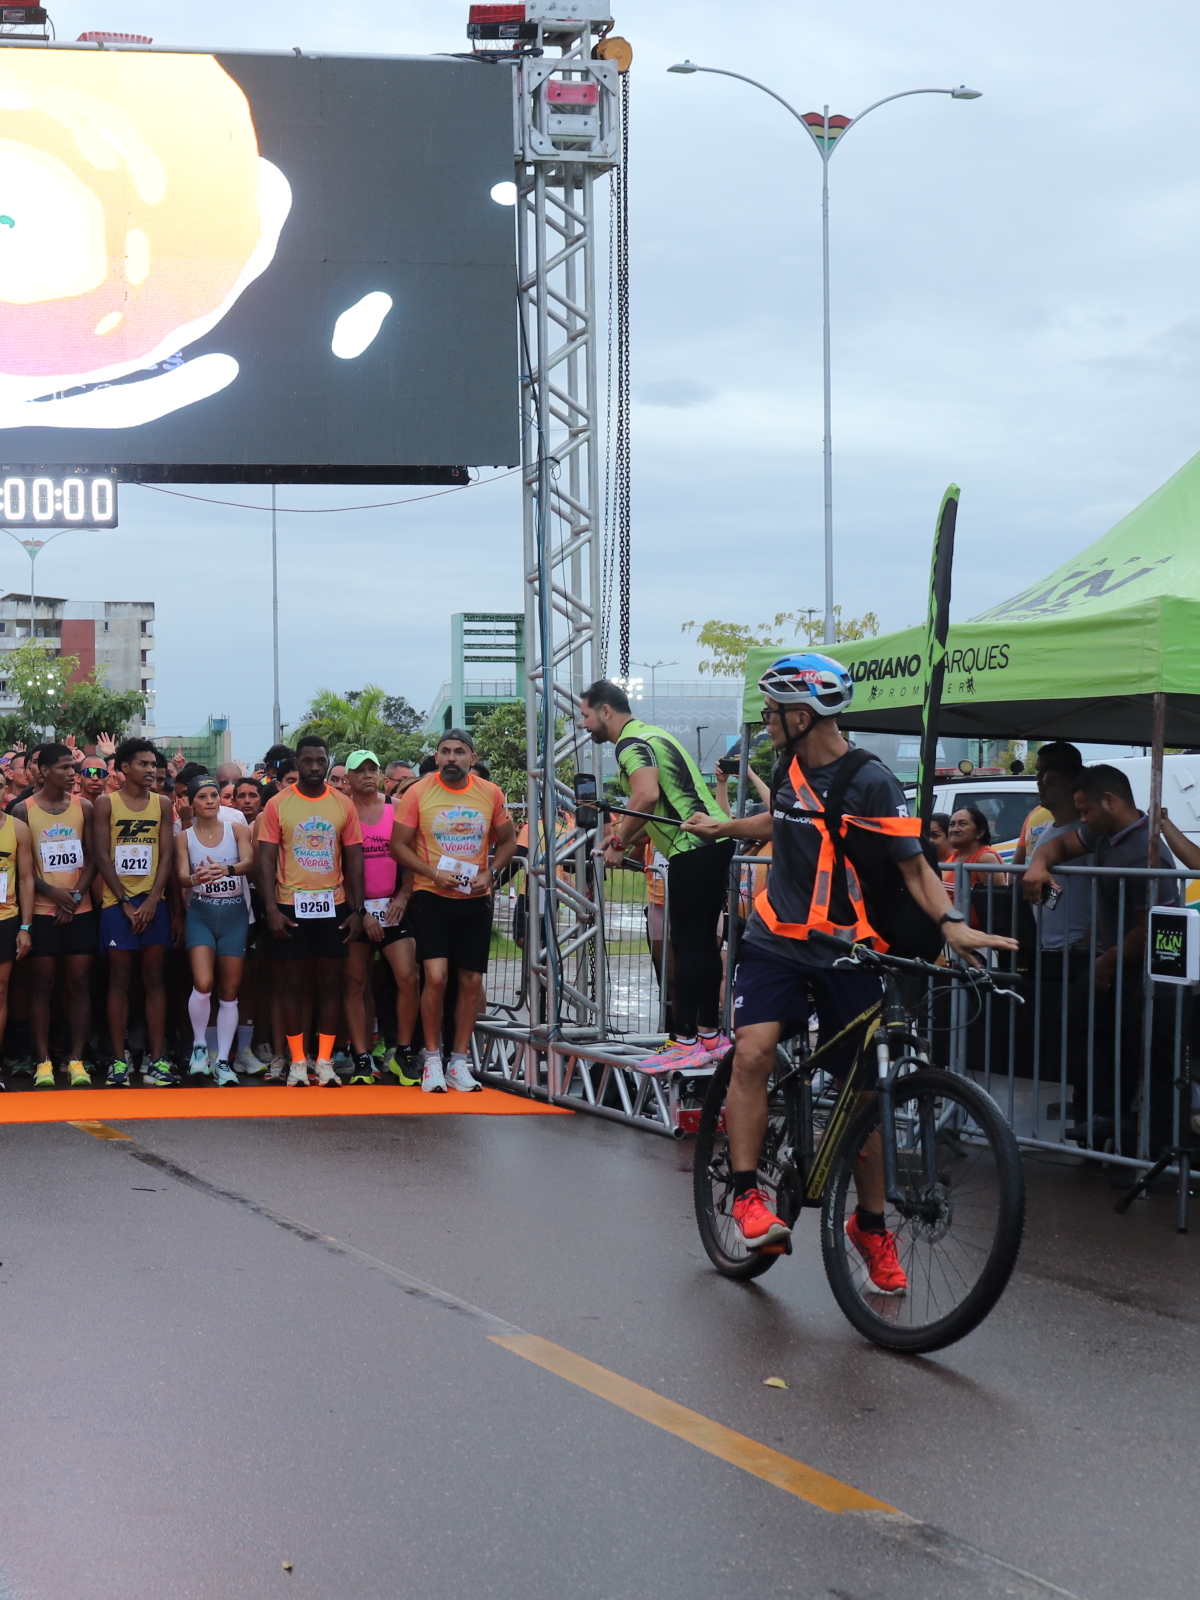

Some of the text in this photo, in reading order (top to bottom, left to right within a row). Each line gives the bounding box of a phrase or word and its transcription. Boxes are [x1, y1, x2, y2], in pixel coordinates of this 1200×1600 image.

[848, 644, 1010, 683] ADRIANO ARQUES
[443, 834, 477, 842] MACAPÁ
[49, 853, 77, 866] 2703
[300, 849, 330, 858] MACAPÁ
[121, 858, 148, 870] 4212
[205, 880, 236, 894] 8839
[221, 897, 242, 906] PRO
[300, 901, 330, 913] 9250
